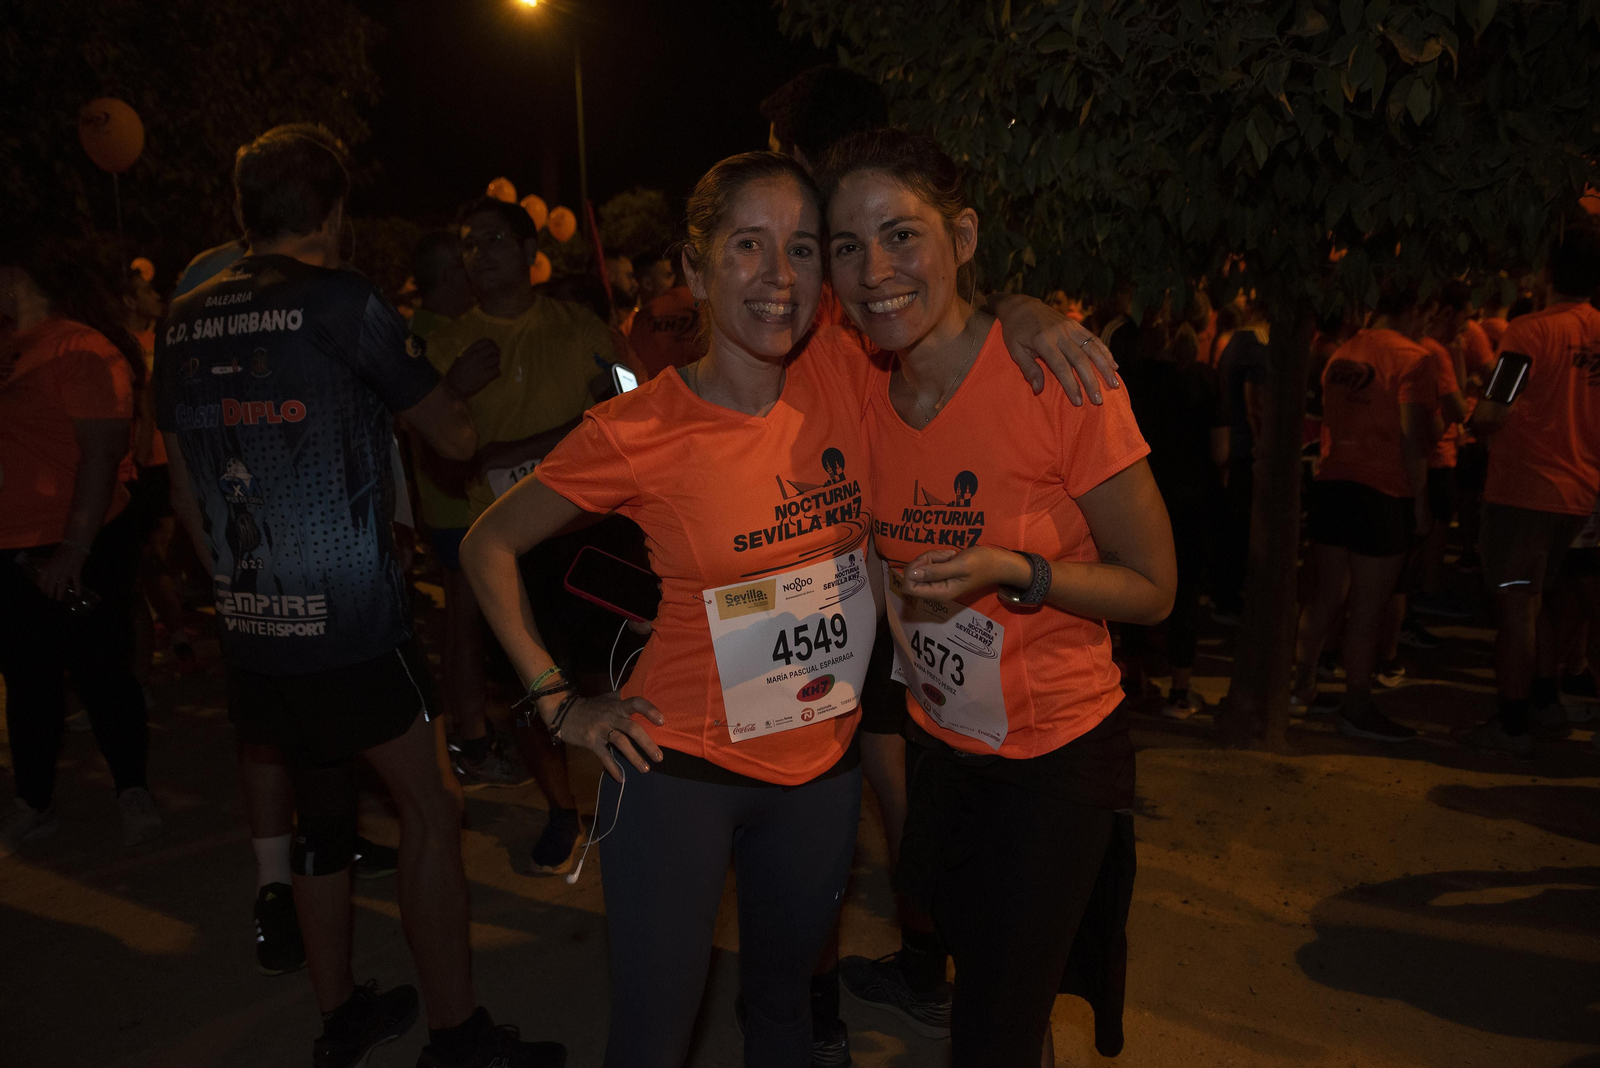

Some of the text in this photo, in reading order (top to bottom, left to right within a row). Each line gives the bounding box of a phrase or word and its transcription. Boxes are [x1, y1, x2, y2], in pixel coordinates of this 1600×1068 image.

[204, 291, 253, 307] BALEARIA
[166, 308, 305, 346] C.D. SAN URBANO
[175, 398, 307, 428] CASH DIPLO
[774, 480, 861, 521] NOCTURNA
[901, 508, 985, 526] NOCTURNA
[733, 514, 822, 553] SEVILLA
[874, 519, 936, 544] SEVILLA
[823, 578, 848, 591] SEVILLA
[834, 565, 860, 579] NOCTURNA
[237, 619, 326, 637] INTERSPORT
[772, 612, 848, 665] 4549
[955, 622, 980, 641] SEVILLA
[968, 623, 994, 641] NOCTURNA
[766, 651, 855, 685] MARÍA PASCUAL ESPÁRRAGA
[911, 629, 965, 687] 4573
